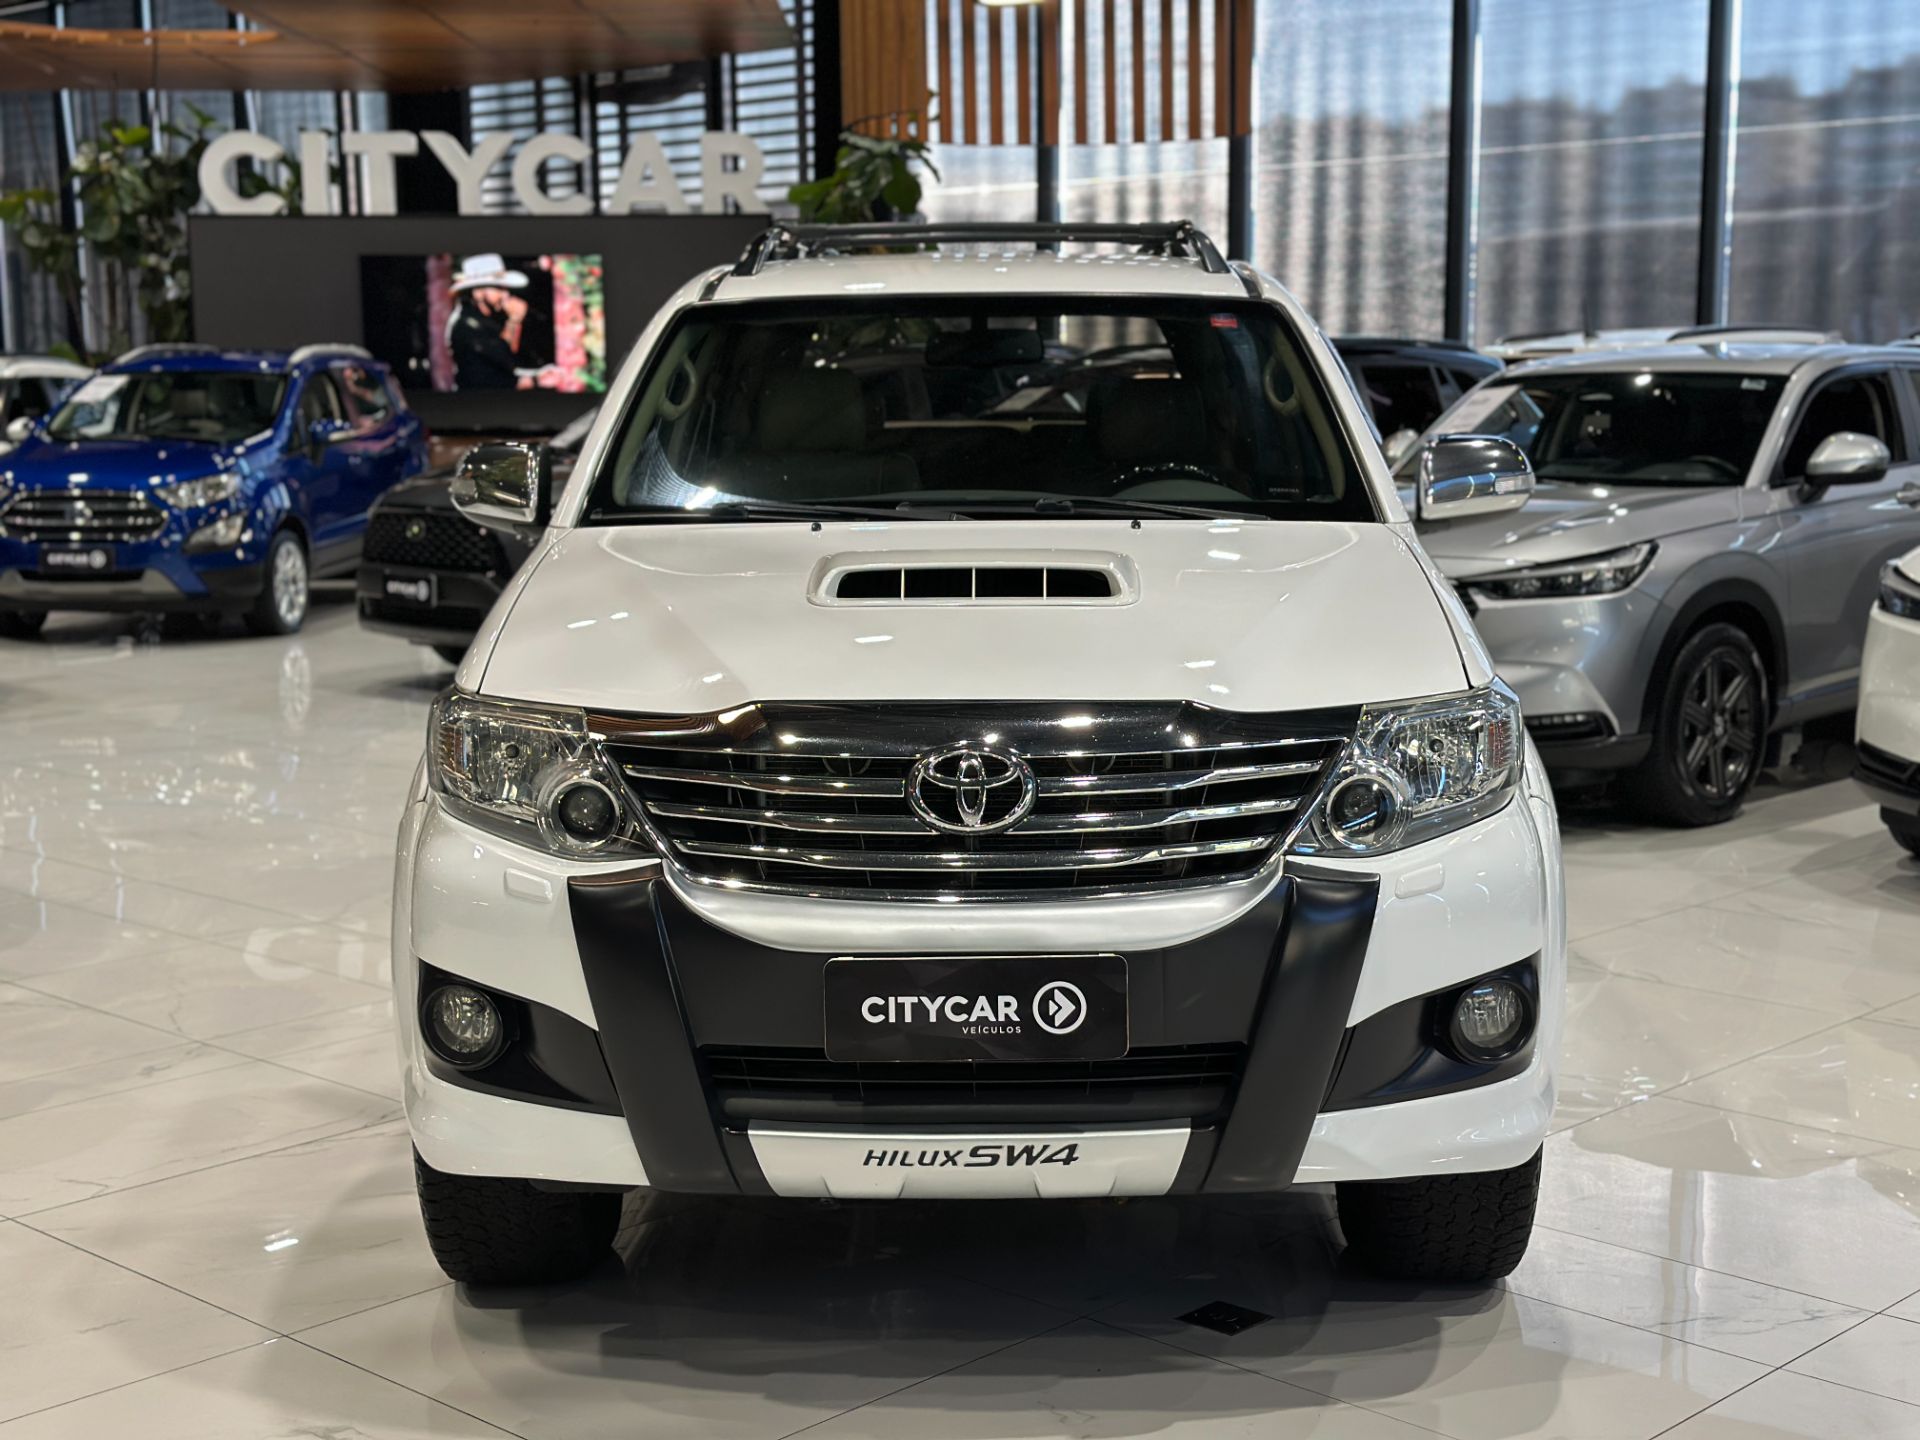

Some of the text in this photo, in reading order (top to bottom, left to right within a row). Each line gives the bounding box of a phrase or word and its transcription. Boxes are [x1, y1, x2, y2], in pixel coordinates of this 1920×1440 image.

[198, 130, 770, 216] CITYCAR
[861, 995, 1021, 1024] CITYCAR
[962, 1024, 1022, 1035] VEÍCULOS
[863, 1143, 1079, 1168] HILUX SW4
